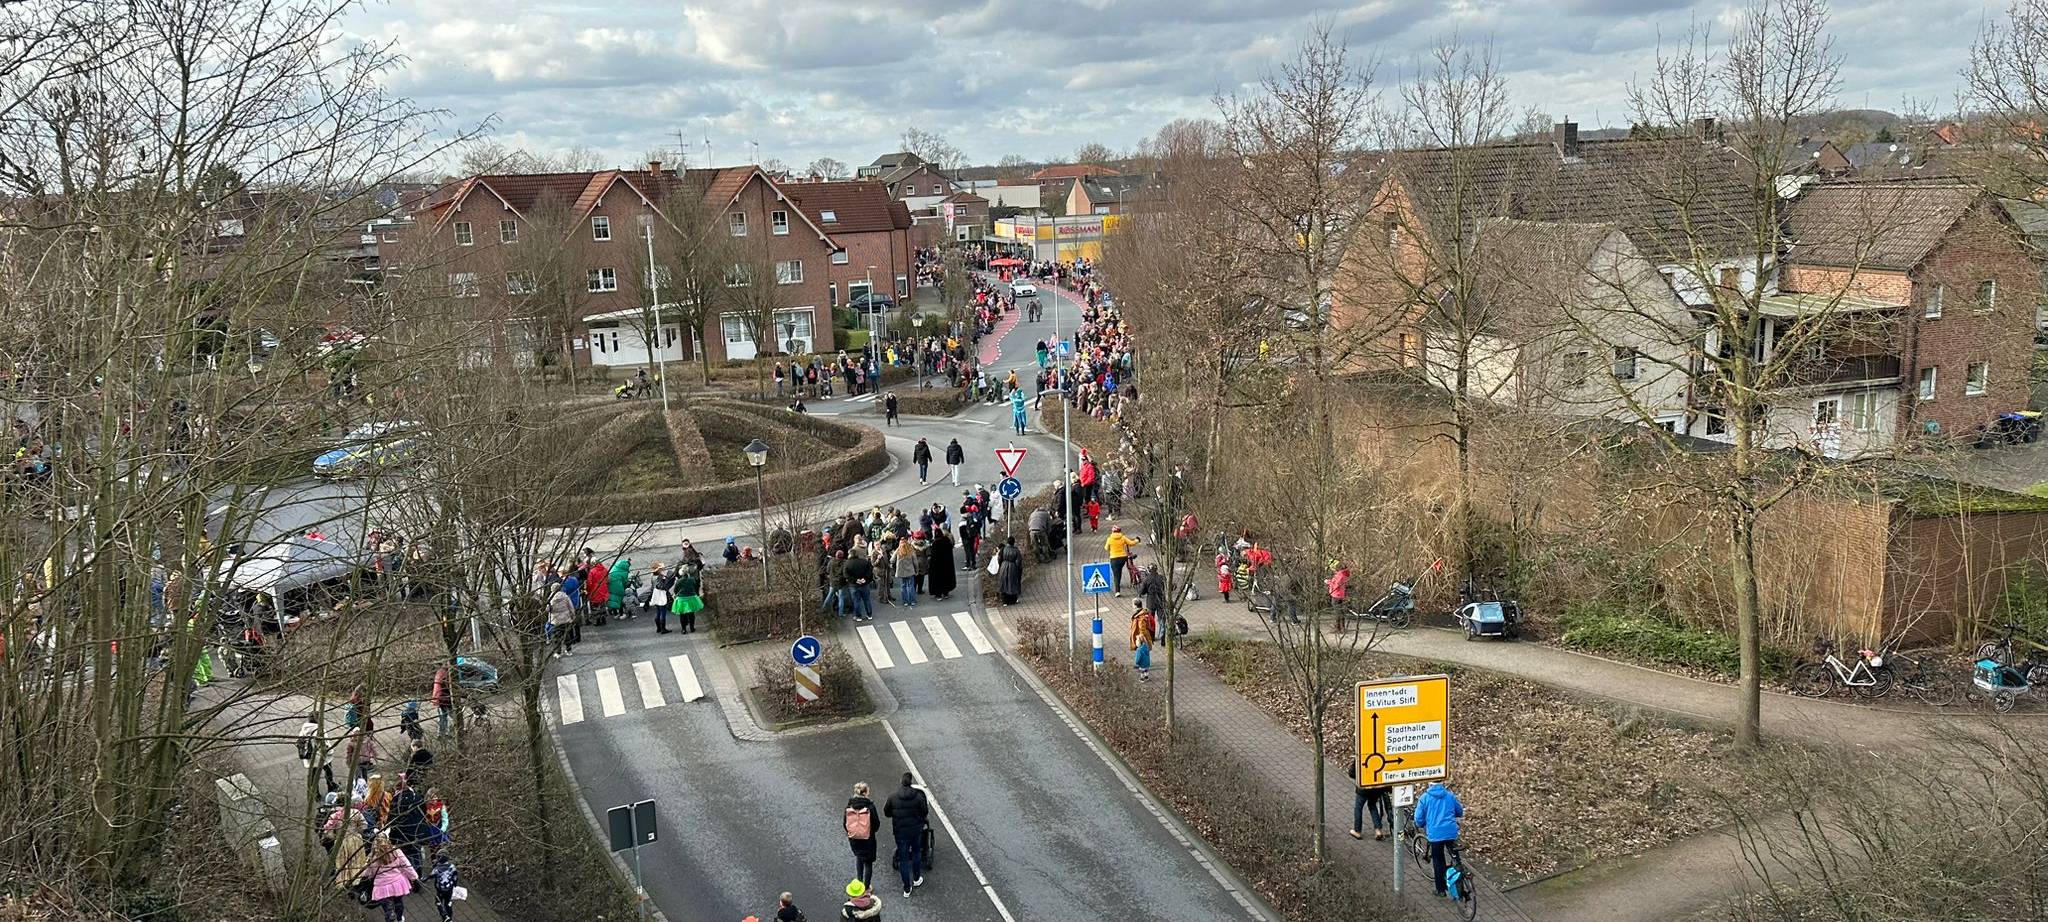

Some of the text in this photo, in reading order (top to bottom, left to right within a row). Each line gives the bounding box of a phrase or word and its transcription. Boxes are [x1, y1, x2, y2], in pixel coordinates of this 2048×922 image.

[1399, 696, 1416, 705] Stift
[1387, 724, 1426, 734] Stadthalle
[1387, 733, 1440, 744] Sportzentrum
[1387, 743, 1419, 753] Friedhof
[1408, 768, 1442, 778] Freizeitpark
